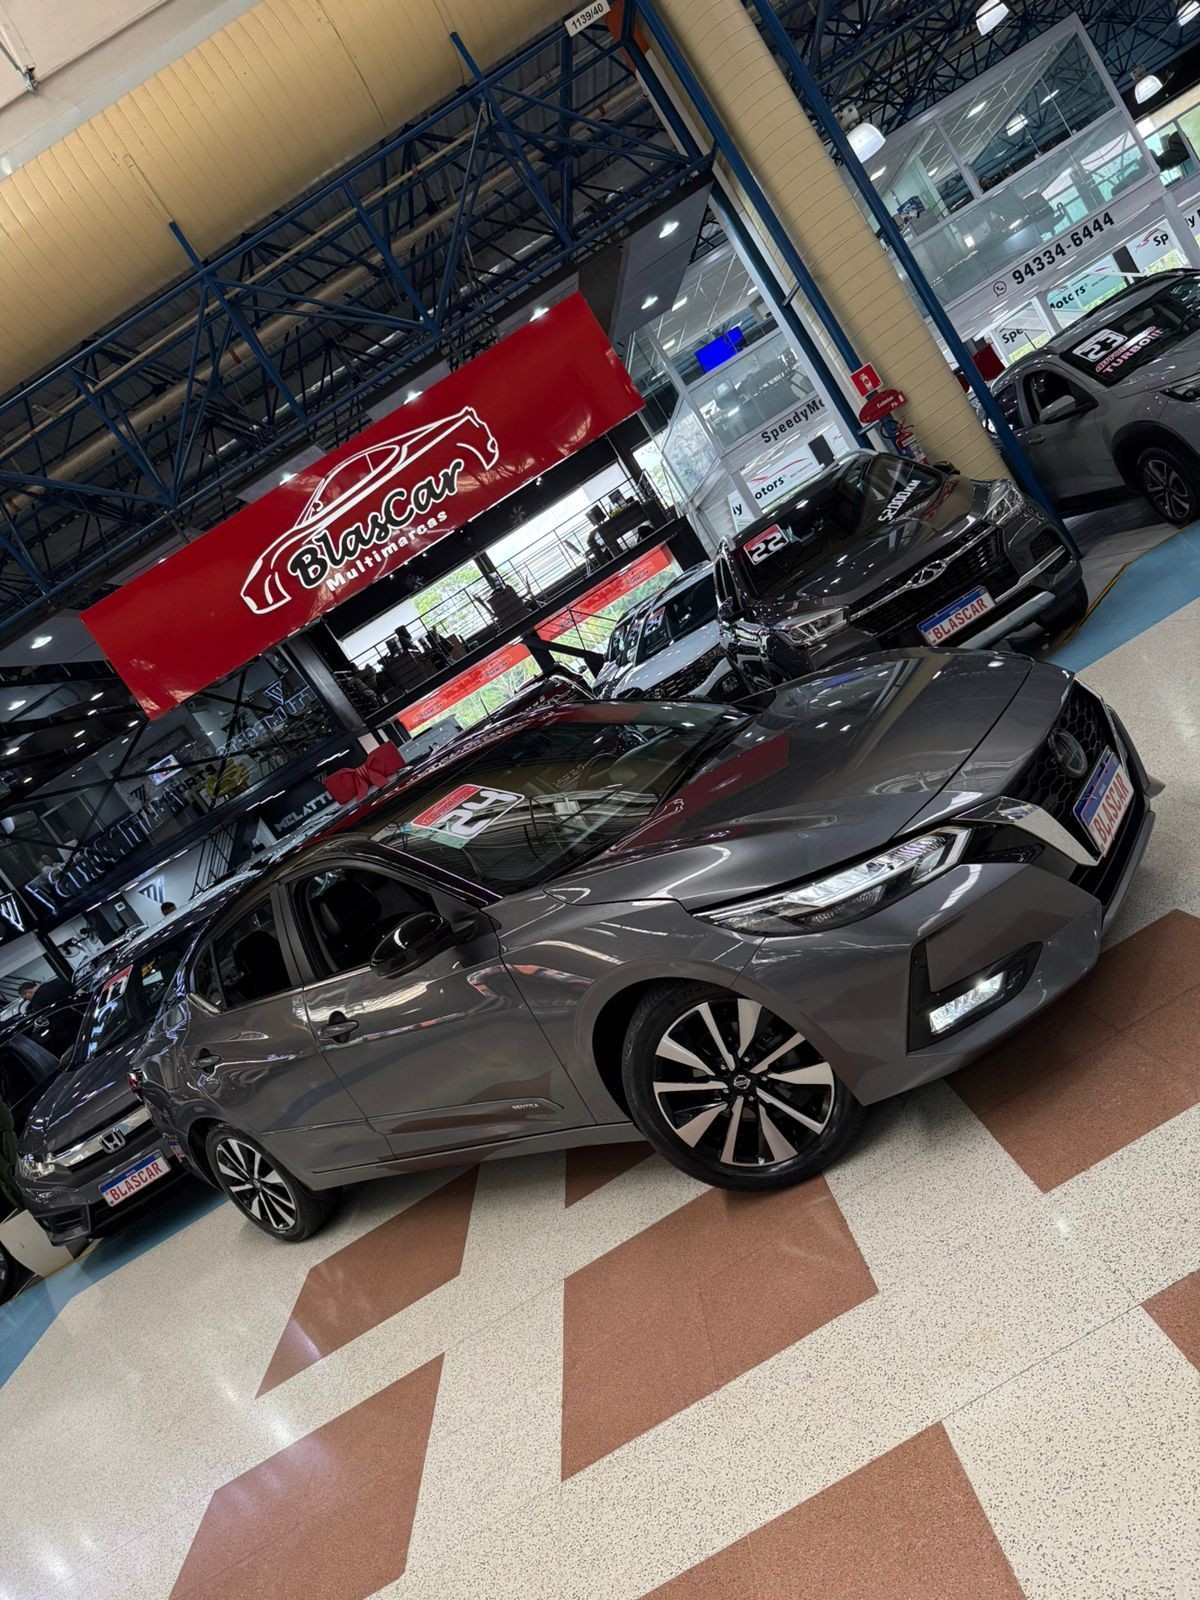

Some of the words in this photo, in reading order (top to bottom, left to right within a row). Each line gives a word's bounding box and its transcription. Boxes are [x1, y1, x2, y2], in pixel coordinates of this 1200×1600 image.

[571, 3, 604, 30] 1139/40
[1011, 212, 1115, 286] 94334-6444
[288, 460, 464, 589] BlasCar
[752, 533, 786, 562] 22
[325, 510, 448, 592] Multimarcas
[932, 599, 989, 642] BLASCAR
[436, 790, 518, 836] 24
[1093, 772, 1130, 845] BLASCAR
[109, 1162, 162, 1201] BLASCAR
